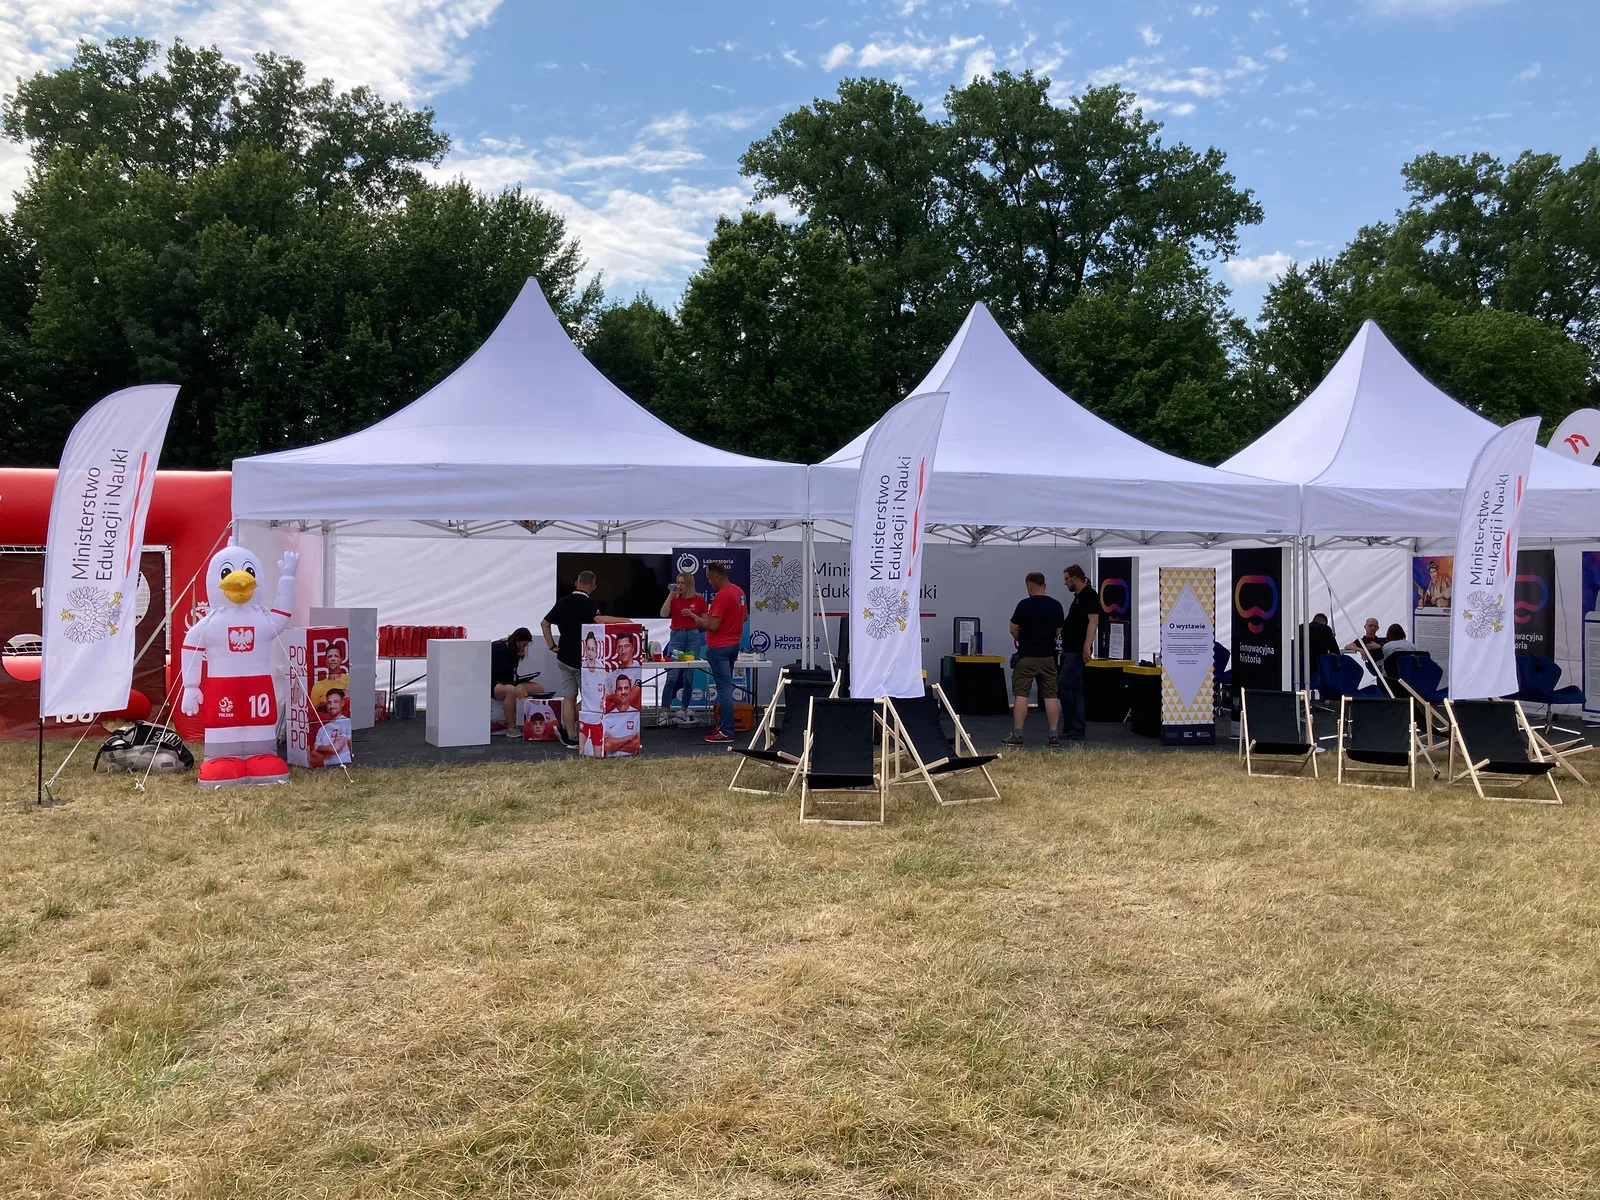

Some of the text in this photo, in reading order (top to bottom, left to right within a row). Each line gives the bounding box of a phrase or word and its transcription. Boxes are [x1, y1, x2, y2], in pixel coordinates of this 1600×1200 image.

[106, 448, 129, 497] Nauki
[893, 456, 912, 502] Nauki
[1491, 474, 1510, 515] Nauki
[71, 467, 101, 580] Ministerstwo
[96, 509, 122, 581] Edukacji
[870, 475, 890, 580] Ministerstwo
[889, 513, 908, 580] Edukacji
[1469, 491, 1490, 586] Ministerstwo
[1486, 526, 1505, 586] Edukacji
[1240, 641, 1275, 656] innowacyjna
[1240, 652, 1262, 665] historia
[248, 693, 270, 719] 10
